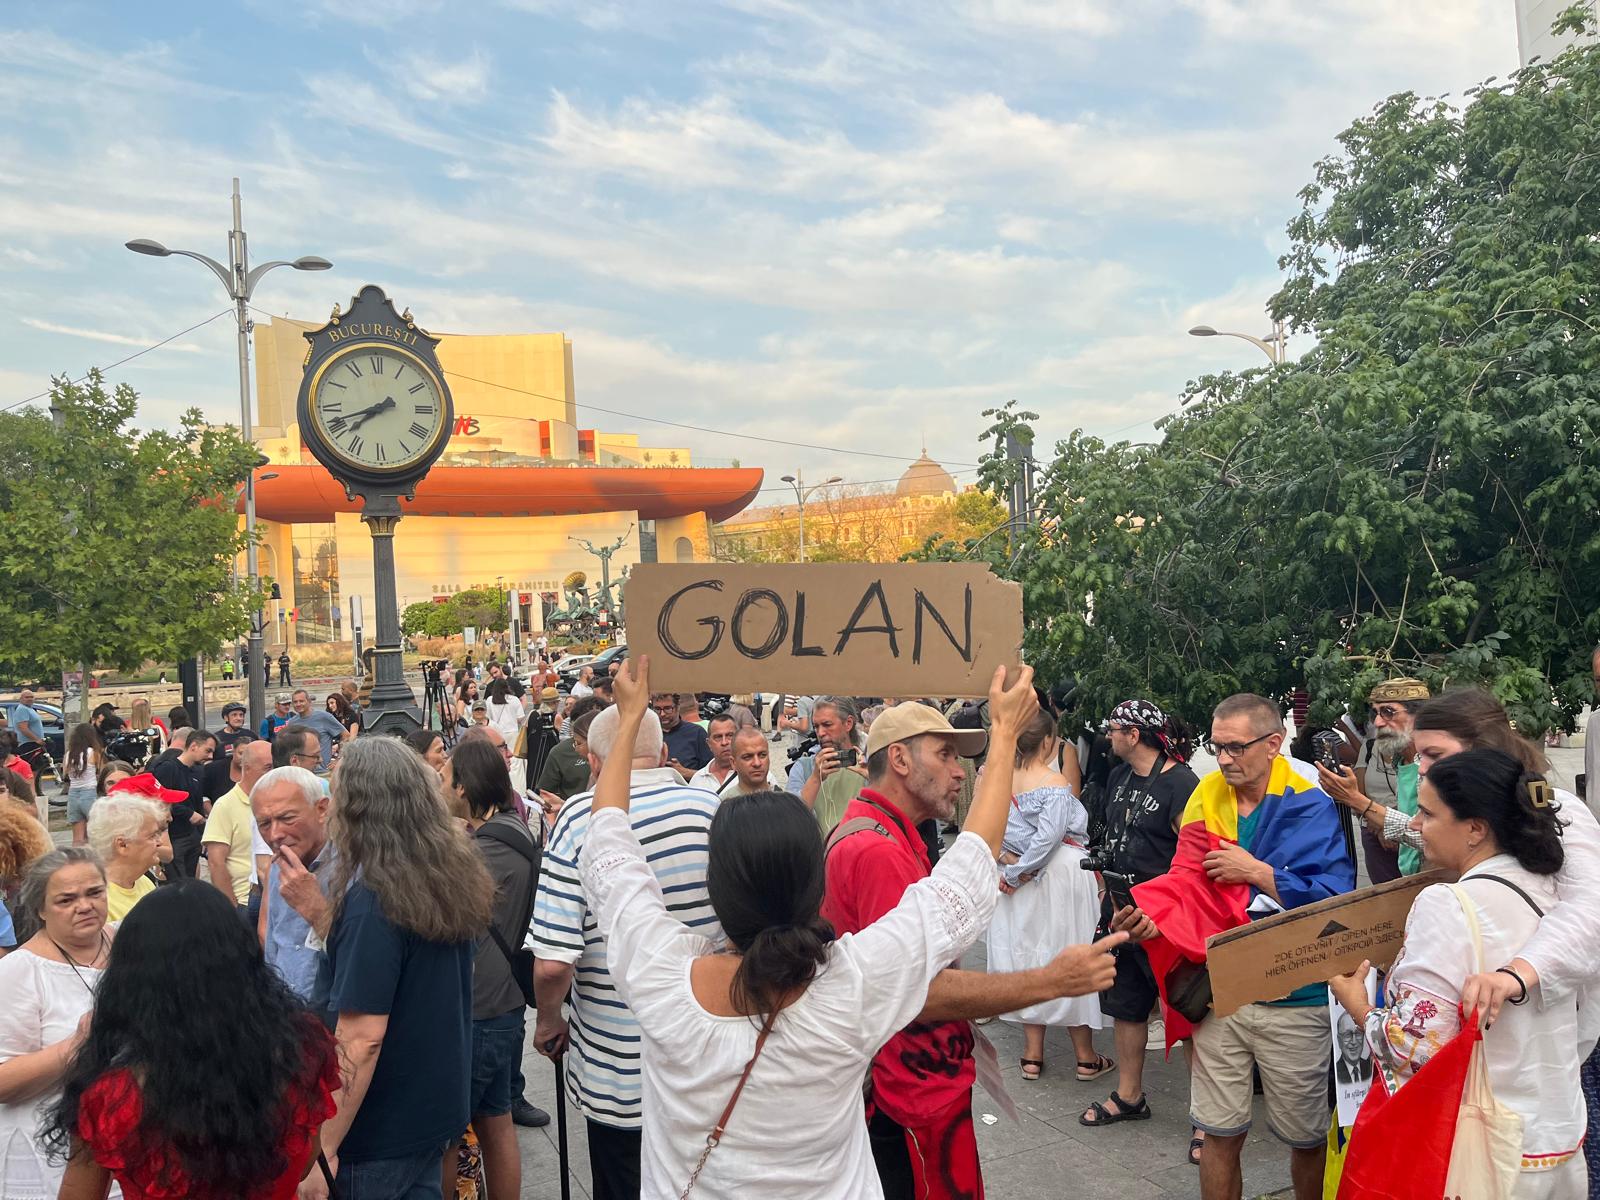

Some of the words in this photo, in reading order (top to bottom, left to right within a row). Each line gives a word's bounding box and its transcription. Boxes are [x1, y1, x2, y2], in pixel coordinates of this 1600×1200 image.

[657, 579, 972, 665] GOLAN
[1341, 928, 1368, 942] OPEN
[1370, 920, 1394, 933] HERE
[1265, 965, 1287, 978] HIER
